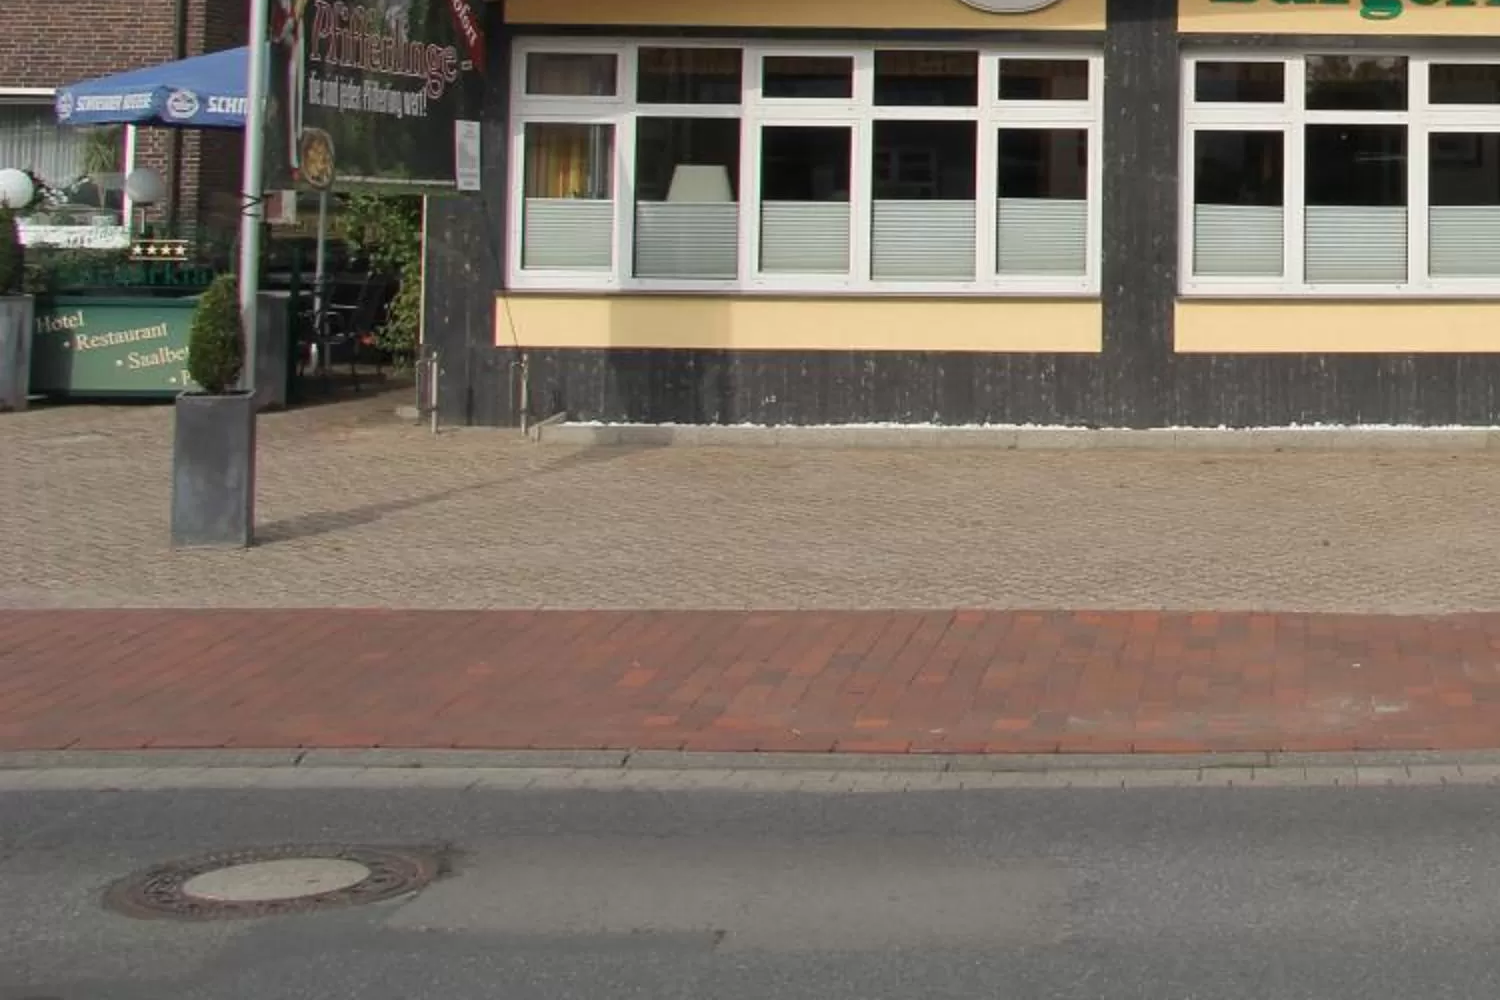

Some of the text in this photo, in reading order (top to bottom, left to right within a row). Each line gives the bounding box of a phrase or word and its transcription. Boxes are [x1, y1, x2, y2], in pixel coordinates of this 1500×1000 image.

[35, 310, 85, 333] Hotel
[75, 322, 169, 351] Restaurant
[126, 345, 190, 370] Saalbe
